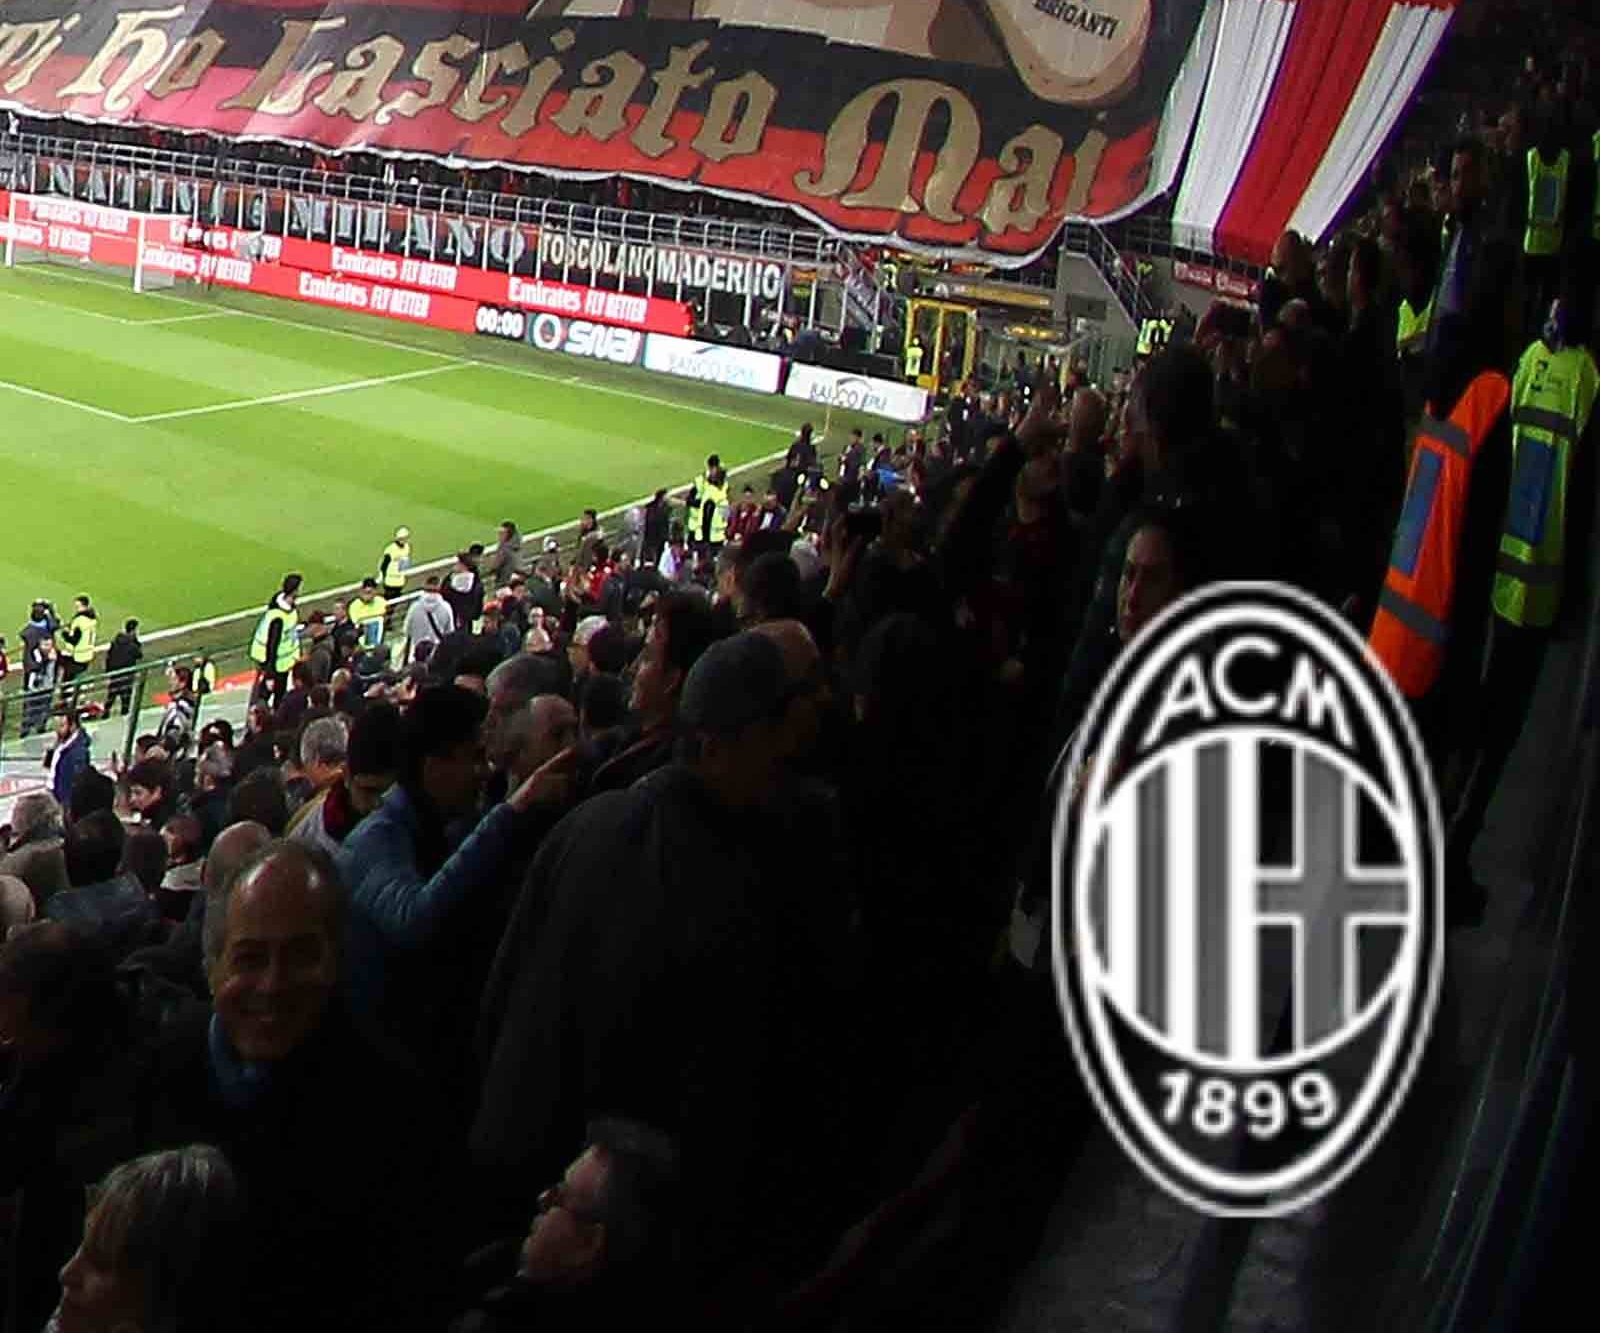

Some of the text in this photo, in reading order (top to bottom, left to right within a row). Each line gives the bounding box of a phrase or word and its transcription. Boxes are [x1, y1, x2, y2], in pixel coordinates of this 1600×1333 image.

[57, 4, 226, 114] Ho
[217, 16, 780, 163] Lasciato
[793, 77, 1108, 236] Mai
[142, 246, 197, 275] Emirates
[331, 247, 397, 278] Emirates
[401, 259, 418, 284] FLY
[541, 232, 655, 279] TOSCOLANO
[299, 273, 367, 306] Emirates
[370, 285, 388, 312] FLY
[509, 276, 581, 311] Emirates
[585, 290, 603, 318] FLY
[475, 306, 524, 338] 00:00
